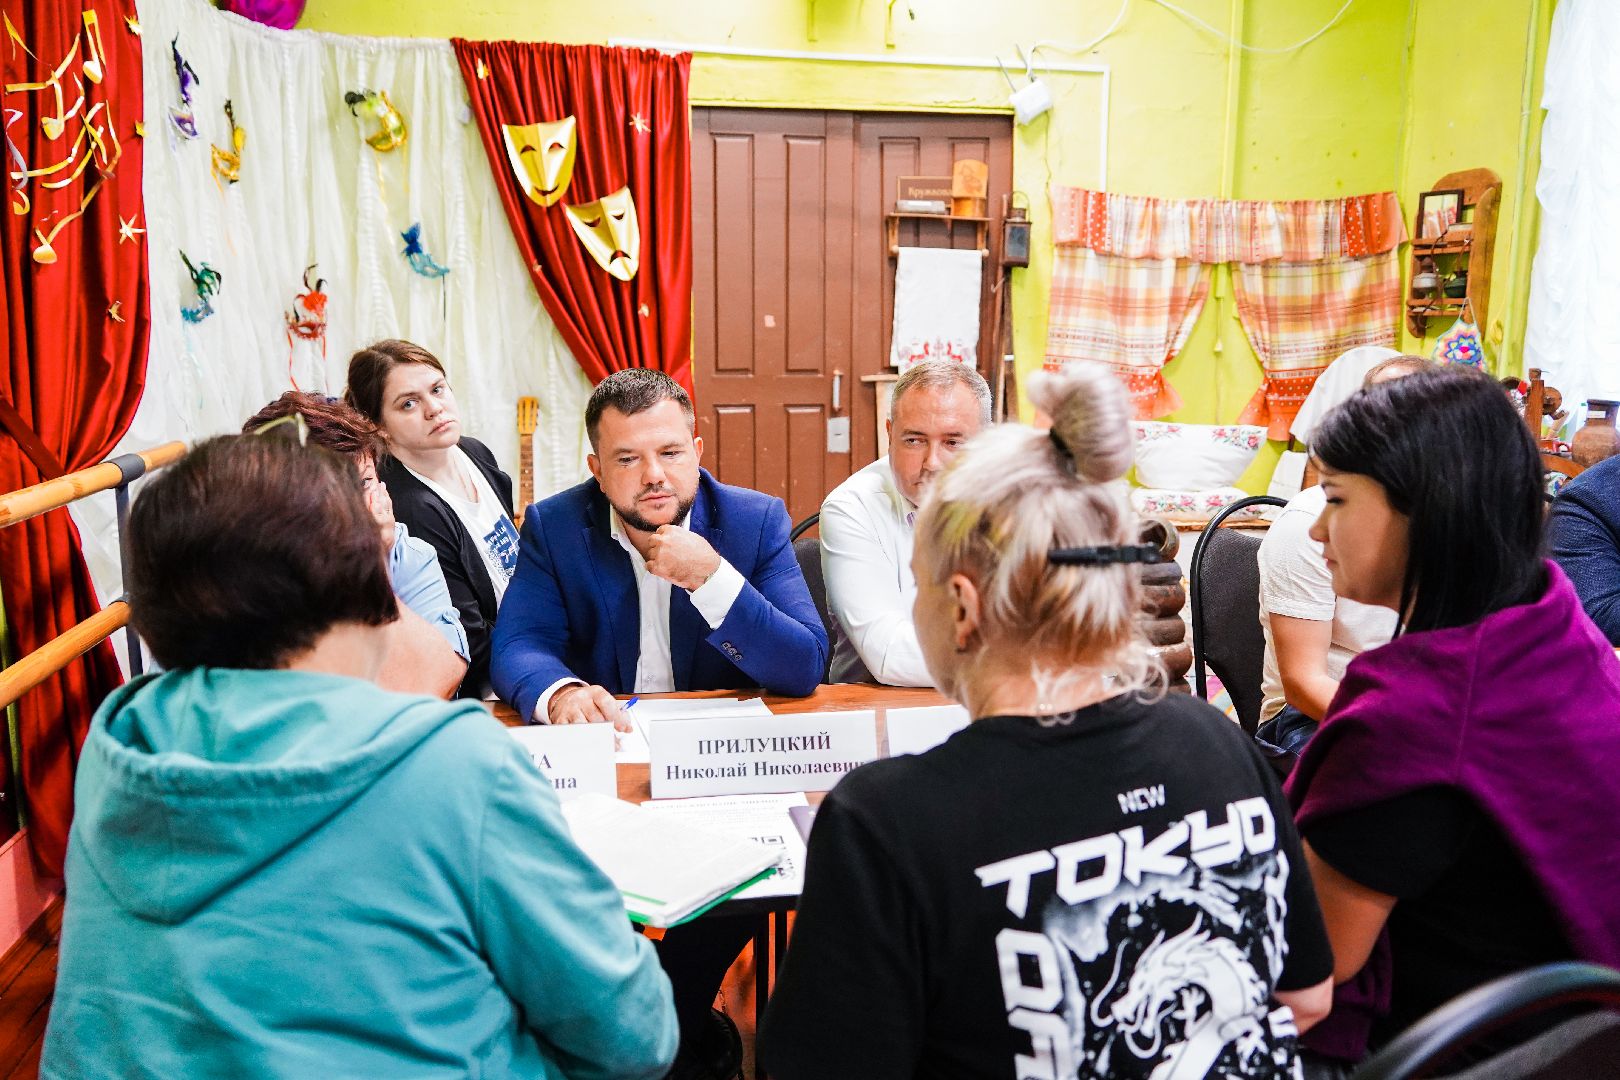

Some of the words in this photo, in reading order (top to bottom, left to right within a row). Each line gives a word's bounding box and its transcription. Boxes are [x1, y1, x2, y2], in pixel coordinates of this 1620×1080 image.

[698, 731, 831, 755] ПРИЛУЦКИЙ
[666, 762, 747, 780] Николай
[1117, 783, 1166, 815] NEW
[974, 796, 1276, 919] TOKYO
